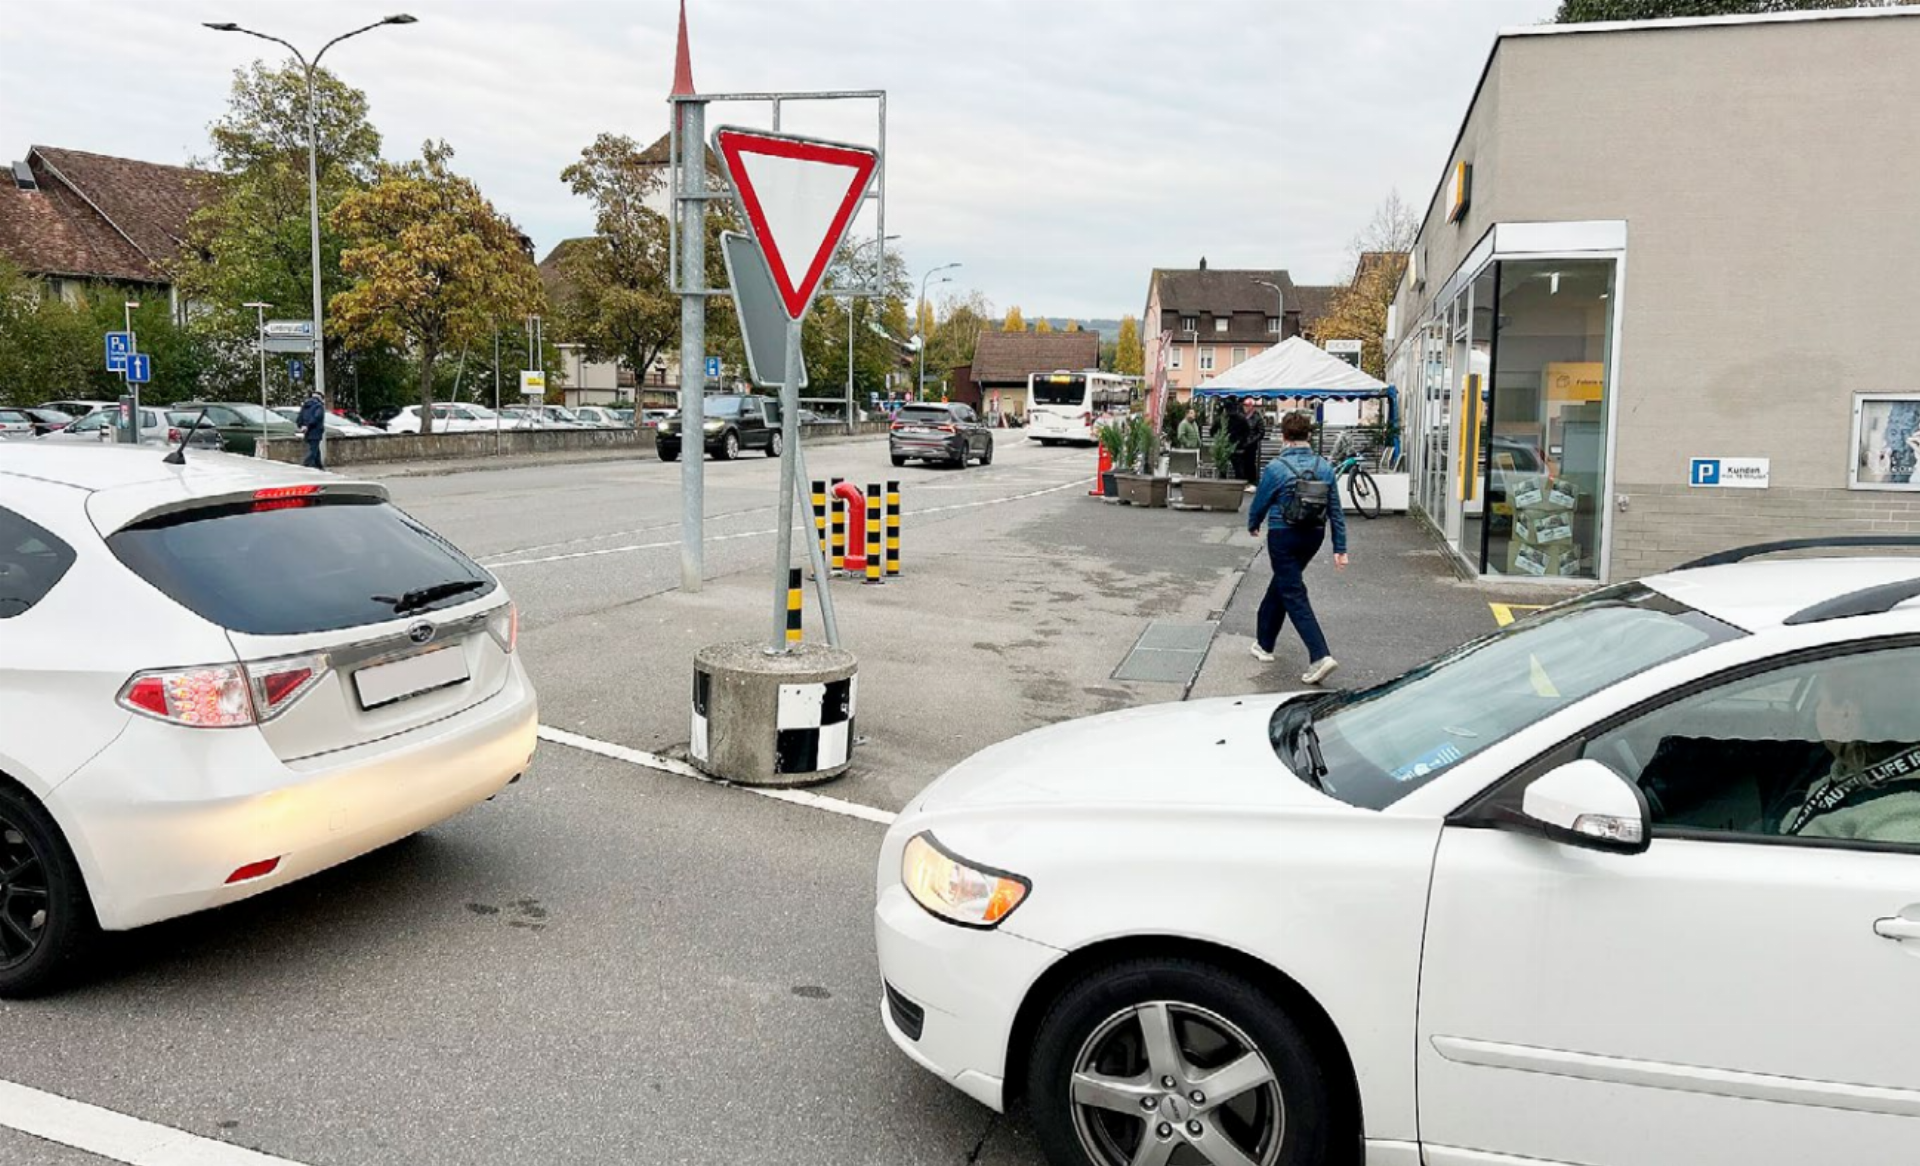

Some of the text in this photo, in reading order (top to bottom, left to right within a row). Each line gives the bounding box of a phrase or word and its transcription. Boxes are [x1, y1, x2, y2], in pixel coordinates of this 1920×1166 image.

[1699, 464, 1714, 483] P
[1727, 466, 1761, 475] Kunden
[1871, 758, 1910, 780] LIFE
